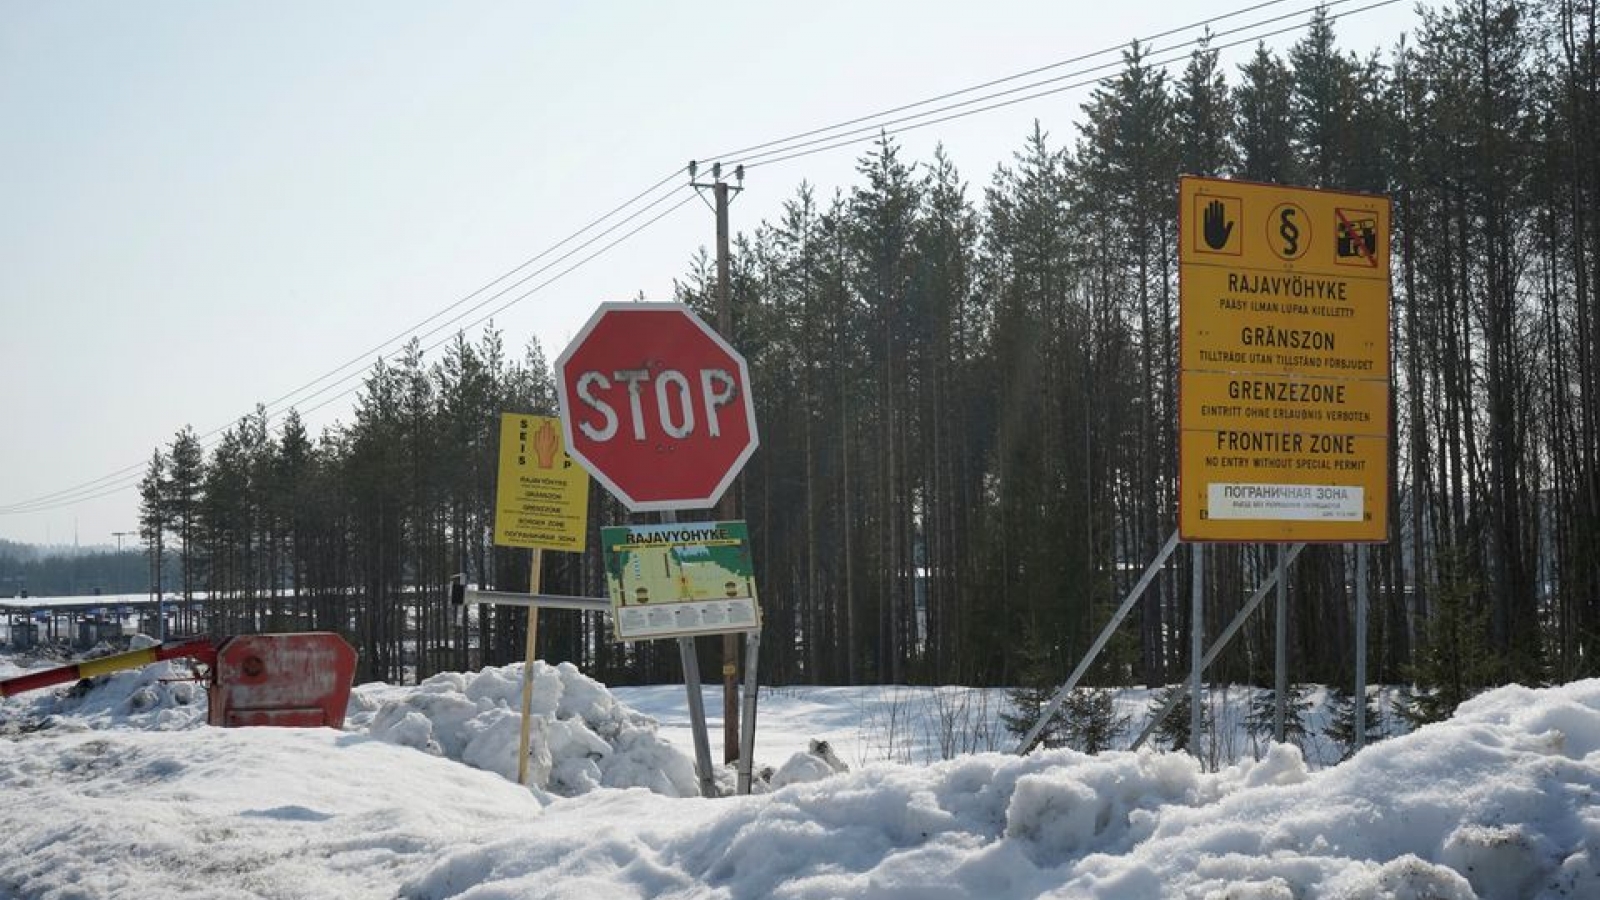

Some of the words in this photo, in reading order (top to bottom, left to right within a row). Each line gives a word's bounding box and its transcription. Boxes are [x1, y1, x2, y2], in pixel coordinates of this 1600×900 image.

[1228, 273, 1347, 300] RAJAVYÖHYKE
[1251, 301, 1278, 312] ILMAN
[1281, 303, 1309, 315] LUPAA
[1312, 305, 1355, 317] KIELLETTY
[1241, 325, 1335, 351] GRÄNSZON
[1250, 352, 1273, 364] UTAN
[1229, 380, 1346, 404] GRENZEZONE
[576, 368, 736, 442] STOP
[1201, 405, 1241, 417] EINTRITT
[1244, 407, 1269, 418] OHNE
[1272, 408, 1323, 421] ERLAUBNIS
[1326, 410, 1370, 423] VERBOTEN
[518, 420, 528, 465] SEIS
[1217, 430, 1302, 452] FRONTIER
[1309, 435, 1355, 454] ZONE
[1206, 456, 1219, 467] NO
[1221, 457, 1249, 468] ENTRY
[1253, 458, 1293, 469] WITHOUT
[1296, 459, 1331, 470] SPECIAL
[1334, 460, 1366, 471] PERMIT
[1224, 485, 1311, 499] ПОГРАНИЧНАЯ
[1316, 487, 1348, 500] ЗОНА
[626, 527, 728, 544] RAJAVYÖHYKE
